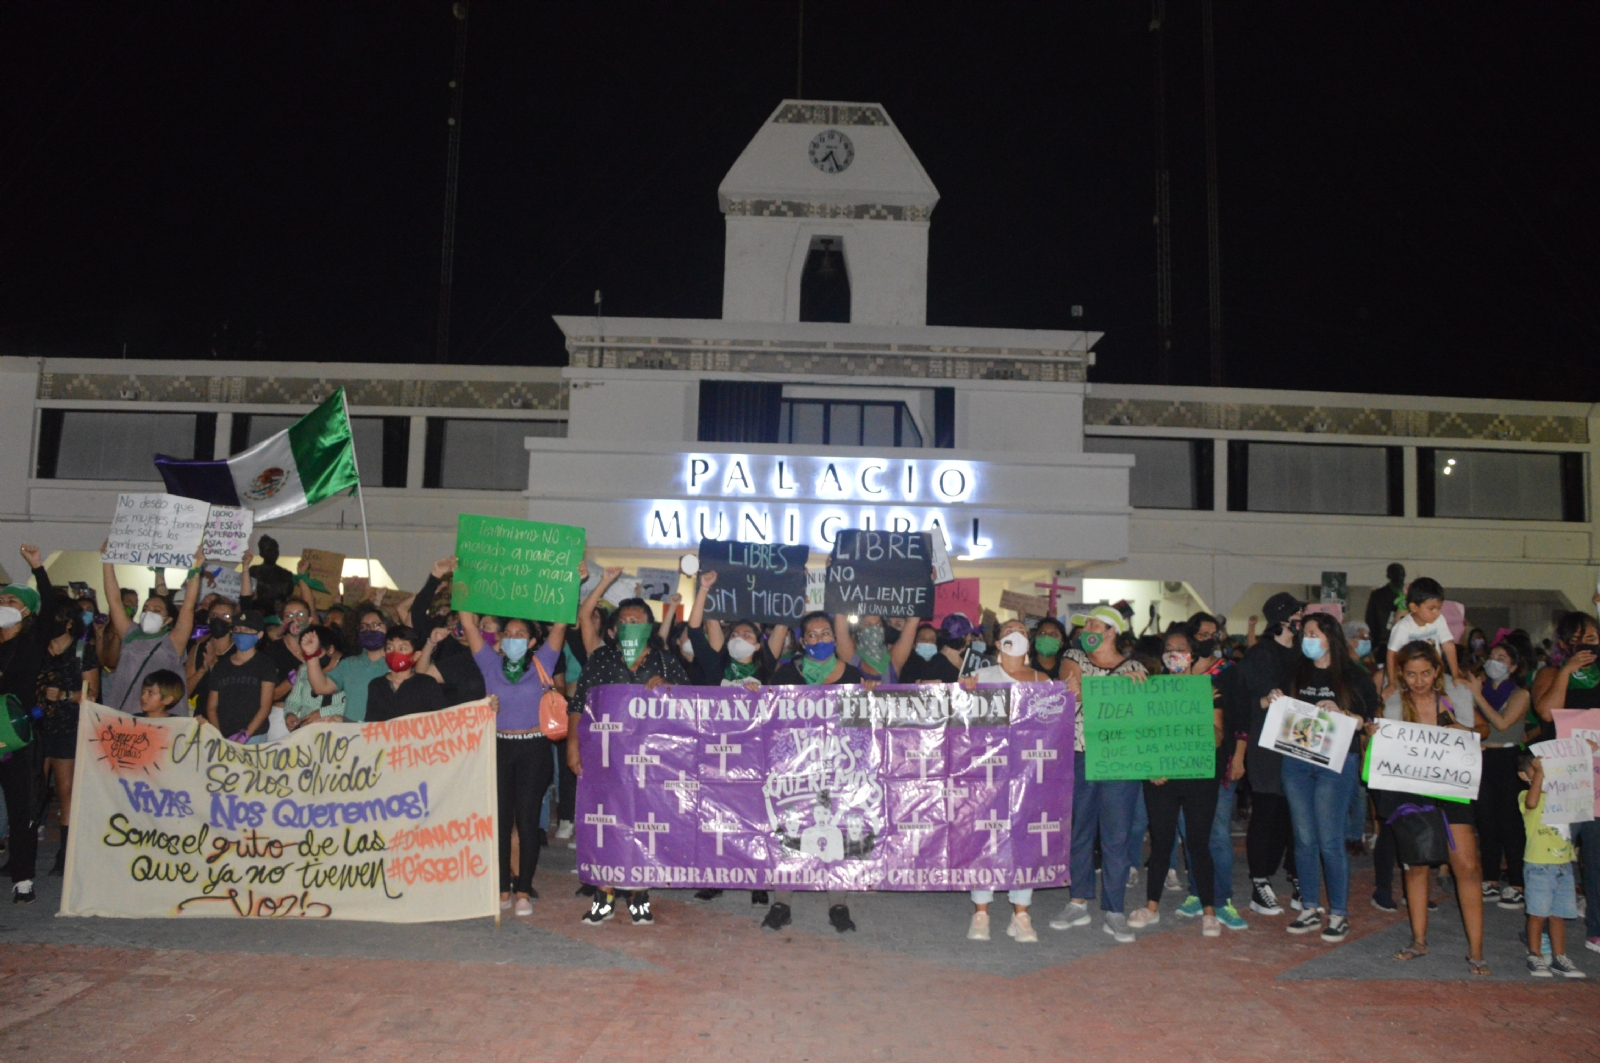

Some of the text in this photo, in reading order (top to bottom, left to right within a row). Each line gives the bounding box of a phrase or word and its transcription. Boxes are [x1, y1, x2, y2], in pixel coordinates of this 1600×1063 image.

[690, 459, 966, 497] PALACIO
[118, 495, 194, 515] No deseo que
[131, 513, 168, 526] mujeres
[220, 521, 243, 530] ESTOY
[137, 527, 162, 538] sobre
[542, 528, 560, 544] NO
[511, 548, 522, 560] a
[836, 532, 923, 561] LIBRE
[147, 551, 194, 568] MISMAS
[539, 568, 573, 583] mata
[829, 565, 855, 582] NO
[840, 584, 927, 605] VALIENTE
[858, 602, 866, 615] NI
[869, 604, 888, 616] UNA
[628, 696, 772, 721] QUINTANA
[778, 697, 835, 720] ROO
[1097, 700, 1206, 719] IDEA RADICAL
[592, 723, 619, 731] ALEXIS
[1098, 724, 1206, 743] QUE SOSTIENE
[1380, 723, 1466, 751] CRIANZA
[713, 745, 734, 753] NATY
[1026, 750, 1053, 758] ARELY
[1101, 741, 1215, 759] QUE LAS MUJERES
[1095, 755, 1214, 774] SOMOS PERSONAS
[1377, 759, 1472, 785] MACHISMO
[206, 764, 240, 793] Se
[587, 816, 613, 824] DANIELA
[637, 824, 666, 832] VIANCA
[205, 829, 292, 864] grito
[298, 829, 339, 857] de
[203, 863, 243, 894] ya
[246, 863, 292, 884] no
[296, 858, 403, 899] tienen
[631, 865, 757, 884] SEMBRARON
[888, 867, 1003, 886] CRECIERON
